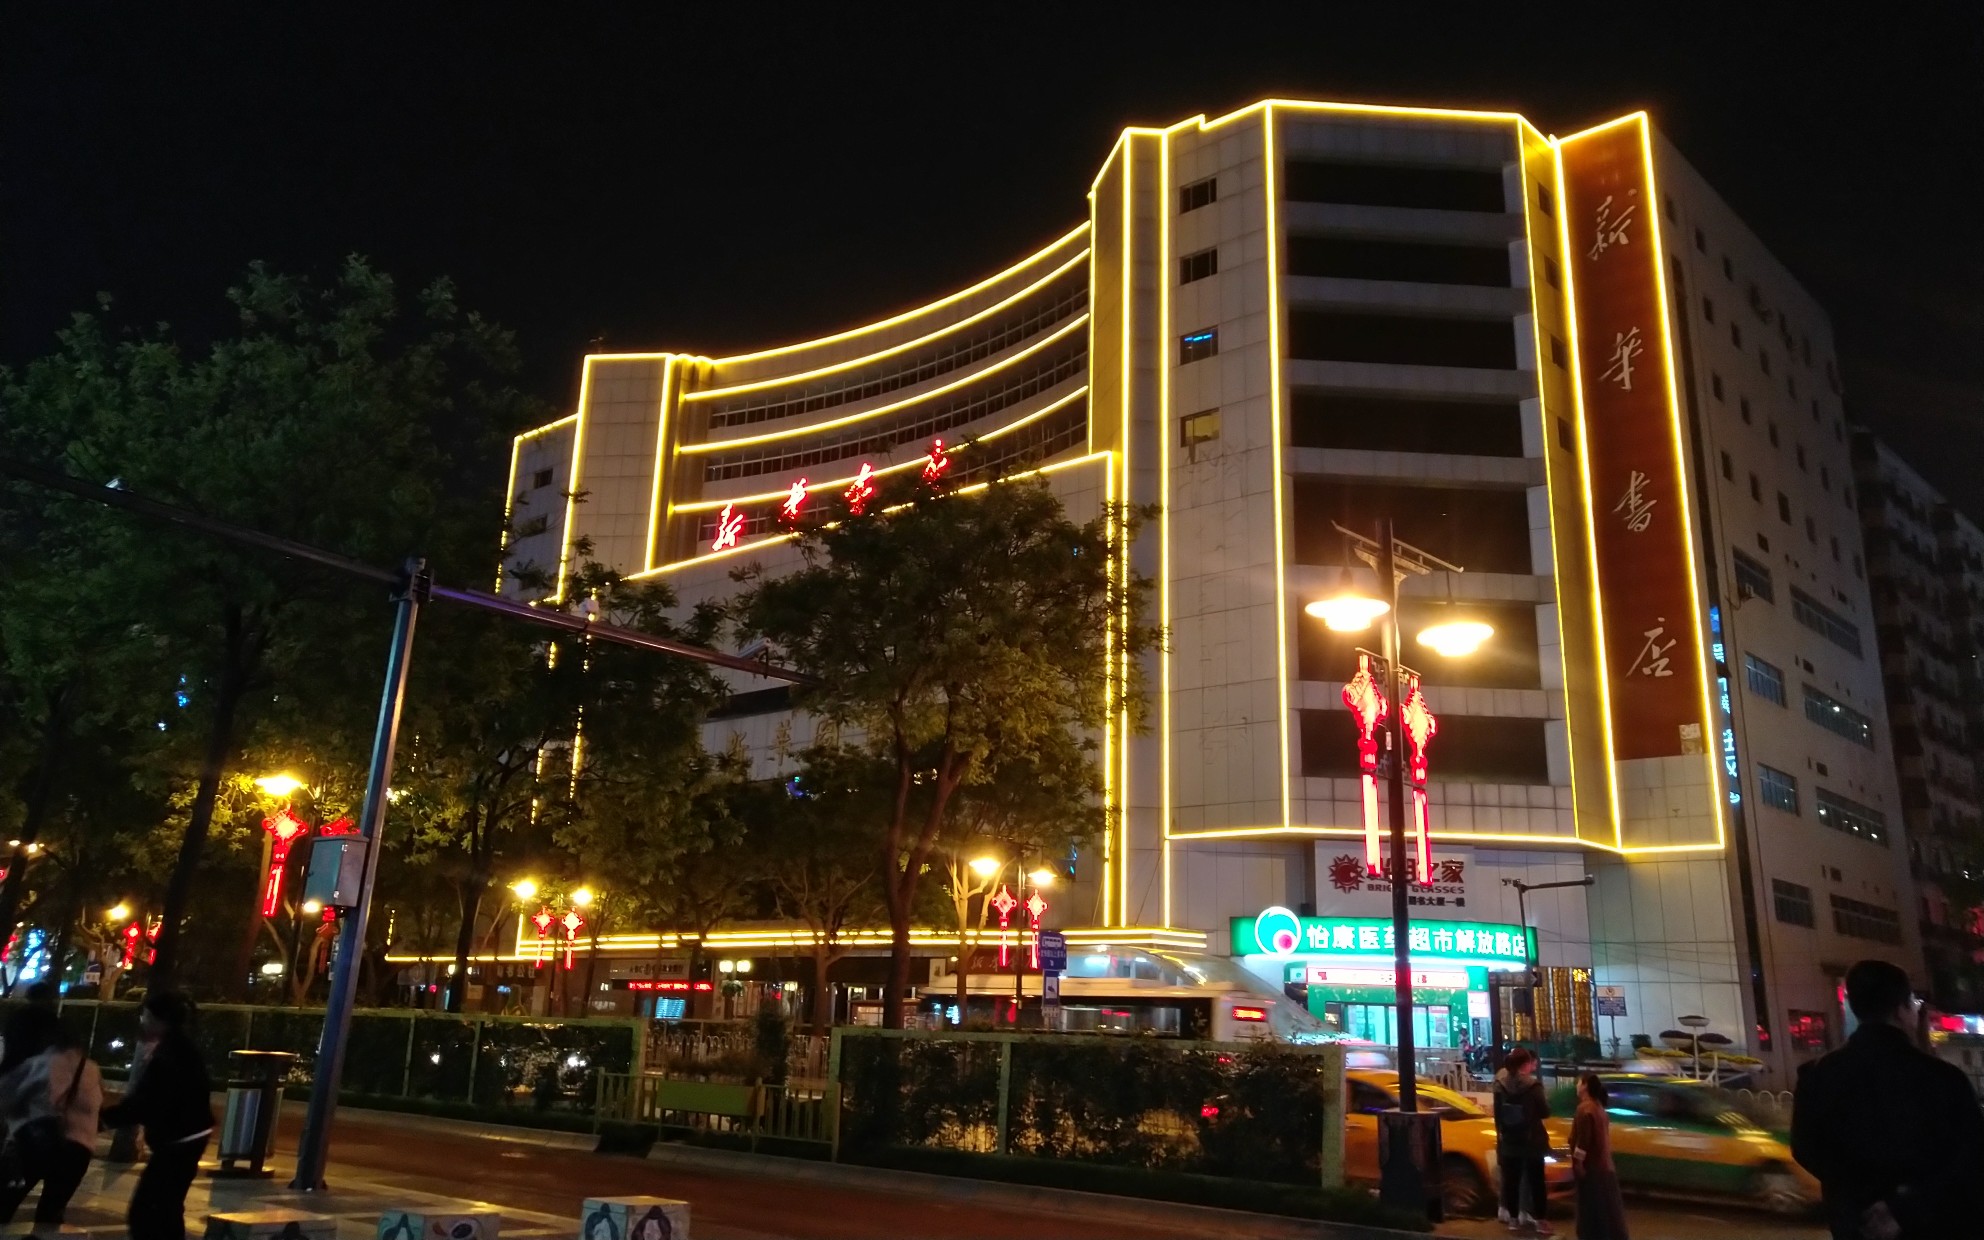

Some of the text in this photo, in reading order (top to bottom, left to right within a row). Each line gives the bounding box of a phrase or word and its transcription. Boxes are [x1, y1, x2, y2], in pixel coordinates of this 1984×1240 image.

[1306, 924, 1528, 957] 怡康医药超市解放路店
